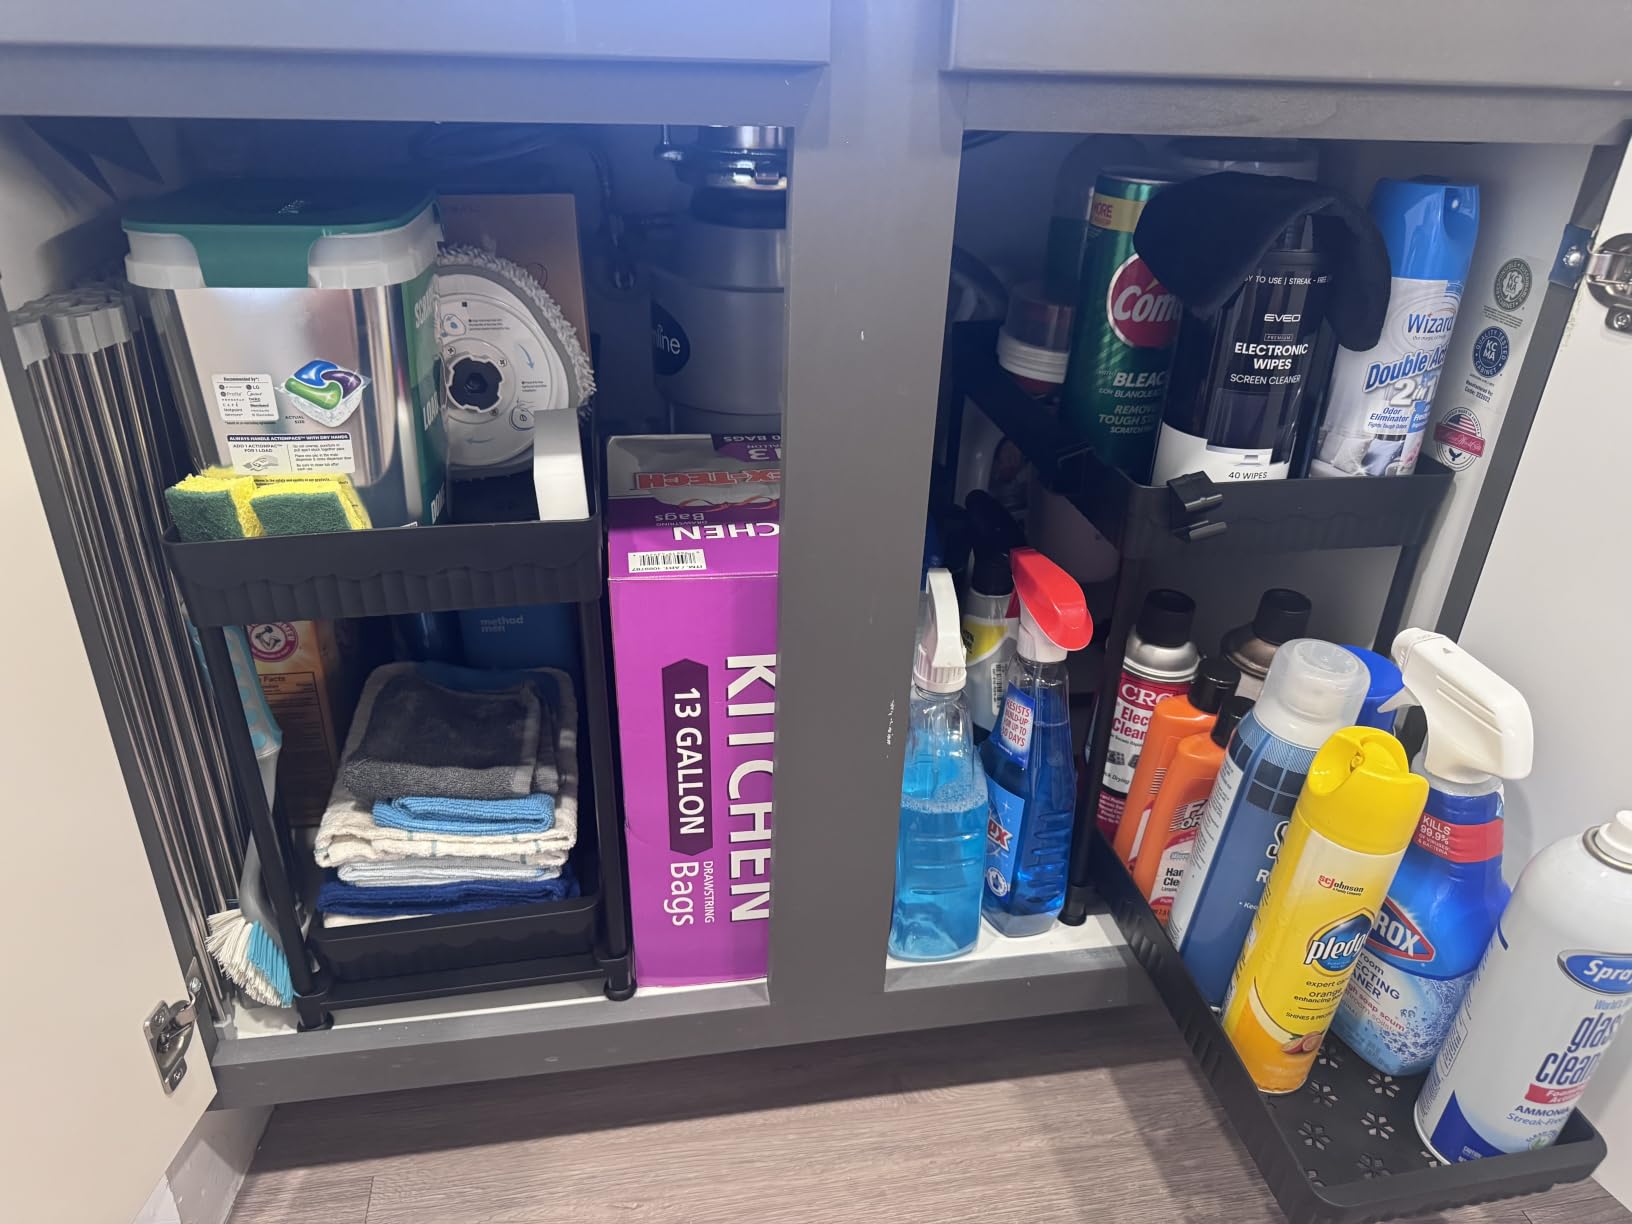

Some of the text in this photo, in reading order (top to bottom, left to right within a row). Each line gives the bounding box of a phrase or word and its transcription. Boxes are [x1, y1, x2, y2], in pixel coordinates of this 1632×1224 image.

[1256, 275, 1266, 284] TO
[1268, 277, 1282, 285] USE
[1288, 277, 1312, 285] STREAK
[1407, 313, 1454, 334] Wizard
[1234, 342, 1309, 356] ELECTRONIC
[1253, 358, 1292, 370] WIPES
[1364, 350, 1429, 392] Double
[1230, 373, 1301, 385] SCREEN CLEANER
[1389, 379, 1416, 407] 2
[1370, 413, 1409, 423] Eliminator
[1382, 407, 1403, 415] Odor
[1228, 471, 1268, 479] 40 WIPES
[655, 512, 704, 521] Bags
[1006, 699, 1029, 717] RESISTS
[1019, 726, 1027, 736] TO
[1008, 732, 1026, 747] DAYS
[673, 687, 705, 835] 13 GALLON
[726, 654, 777, 922] KITCHEN
[1423, 815, 1451, 836] KILLS
[1420, 824, 1449, 845] 99.9%
[663, 861, 700, 926] Bags
[703, 860, 715, 924] DRAWSTRING
[1305, 980, 1335, 988] expert
[1359, 993, 1379, 1013] soap
[1379, 1010, 1405, 1032] scum
